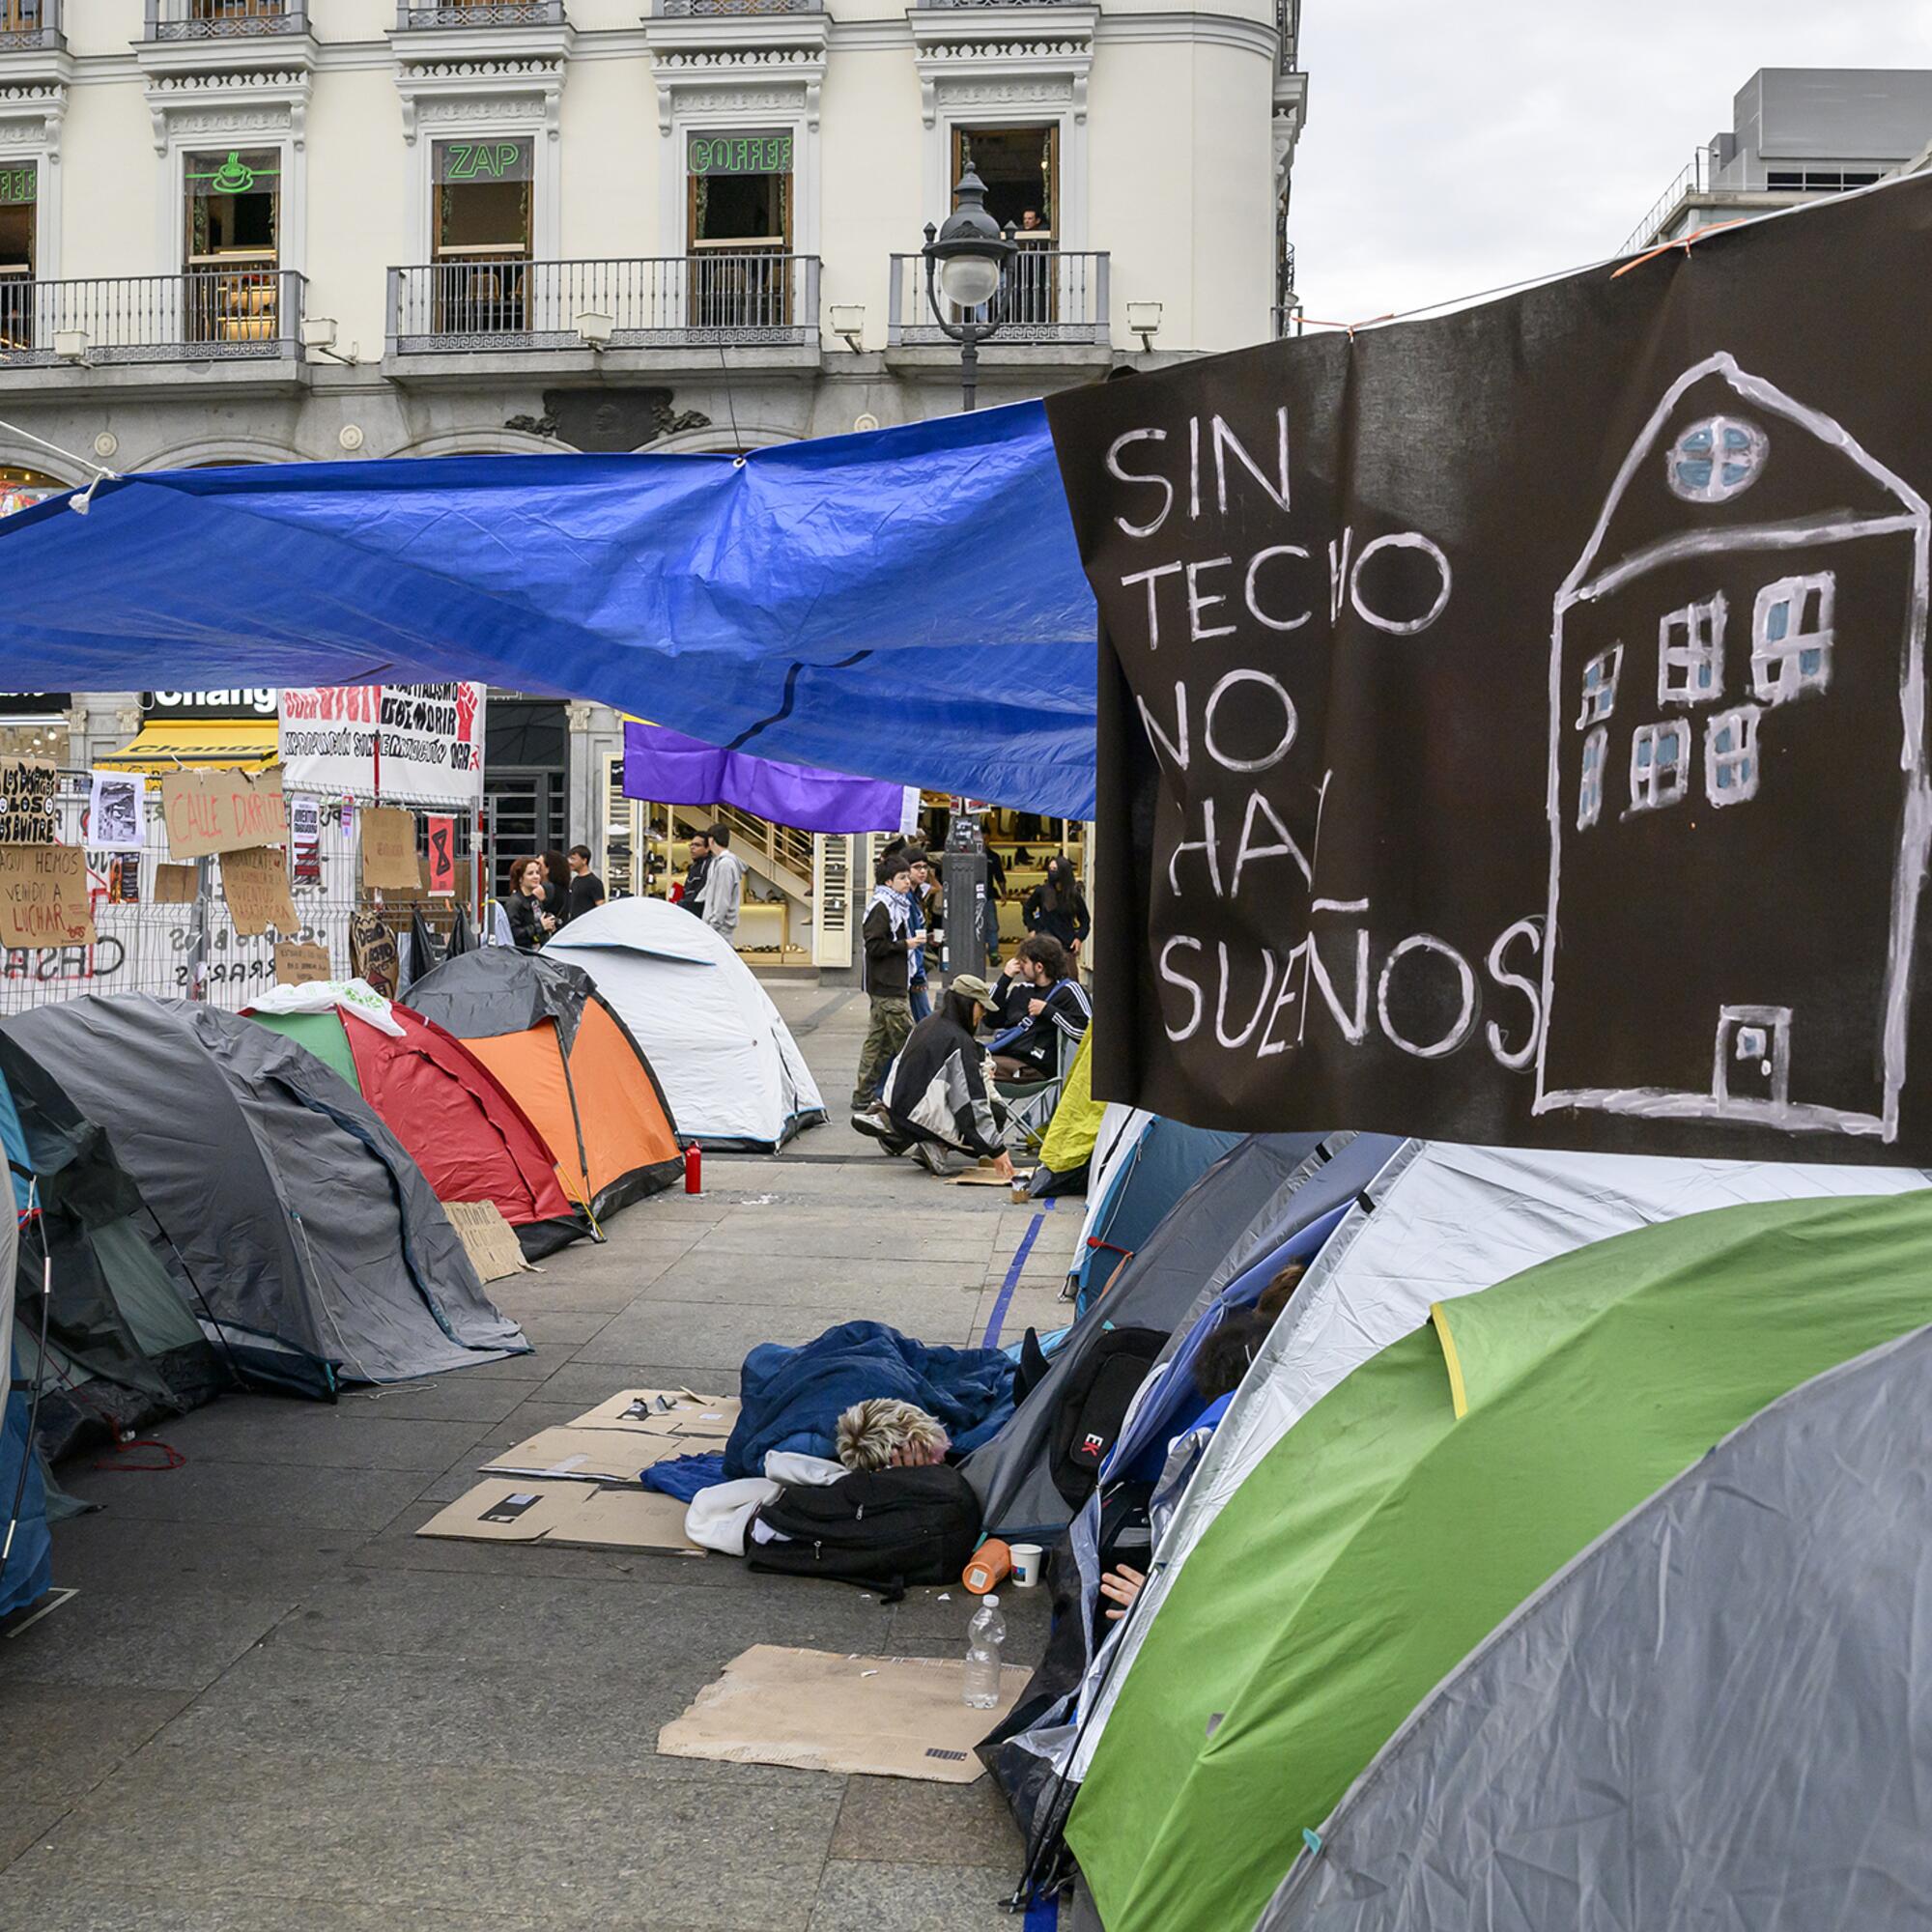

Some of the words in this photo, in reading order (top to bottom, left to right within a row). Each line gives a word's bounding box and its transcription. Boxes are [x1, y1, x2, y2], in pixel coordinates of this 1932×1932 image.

[448, 143, 519, 179] ZAP
[689, 137, 792, 172] COFFEE
[1106, 406, 1292, 538] SIN
[1121, 525, 1452, 650] TECHO
[1136, 668, 1299, 773] NO
[172, 791, 222, 842] CALLE
[36, 852, 79, 875] HEMOS
[53, 883, 63, 902] A
[13, 903, 67, 937] LUCHAR
[1158, 897, 1546, 1070] SUEÑOS
